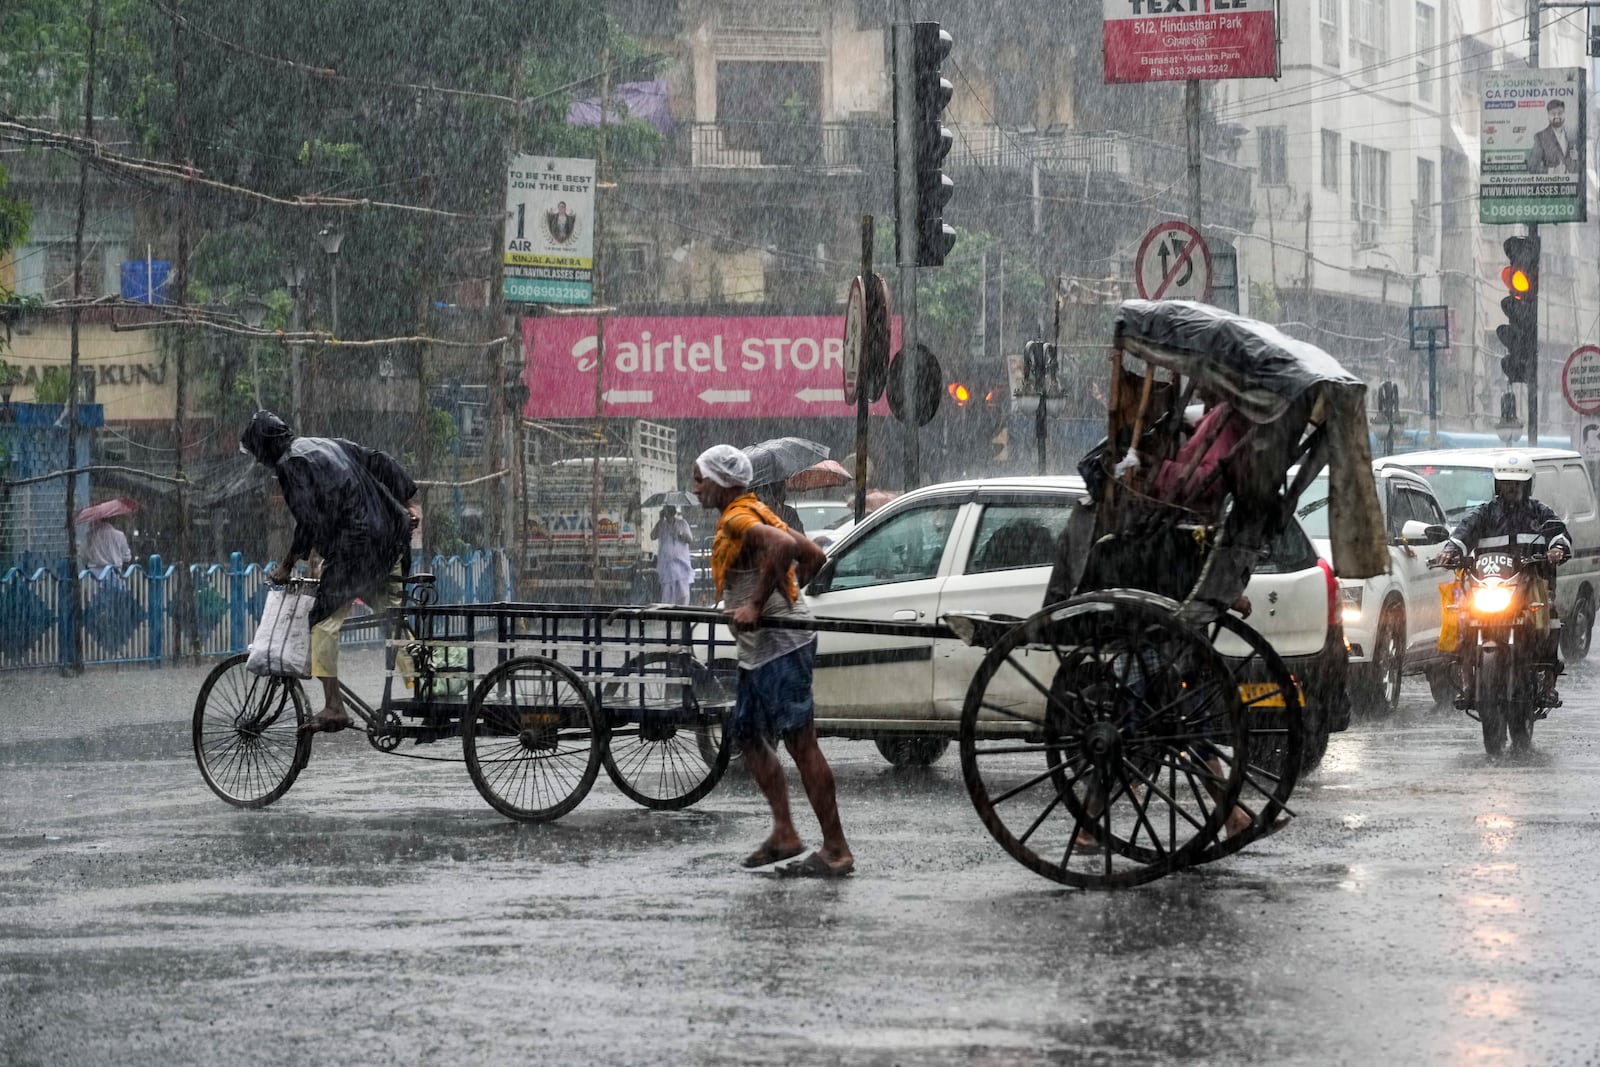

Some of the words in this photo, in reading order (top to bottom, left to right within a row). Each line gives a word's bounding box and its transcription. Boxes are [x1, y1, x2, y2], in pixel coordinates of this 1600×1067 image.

[1134, 20, 1158, 35] 51/2,
[1160, 19, 1217, 33] Hindusthan
[1219, 16, 1242, 30] Park
[1141, 56, 1178, 65] Barasat
[1169, 66, 1185, 75] 033
[1209, 64, 1229, 73] 2242
[1485, 89, 1501, 98] CA
[1504, 87, 1574, 98] FOUNDATION
[510, 170, 523, 179] TO
[526, 172, 539, 180] BE
[542, 173, 564, 182] THE
[566, 175, 592, 183] BEST
[512, 181, 536, 190] JOIN
[539, 183, 559, 191] THE
[563, 184, 590, 193] BEST
[1482, 185, 1577, 196] WWW.NAVINCLASSES.COM
[1490, 204, 1575, 217] 08069032130
[517, 203, 526, 239] 1
[508, 240, 532, 252] AIR
[512, 254, 543, 264] KINJAL
[545, 256, 582, 267] AJMERA
[510, 284, 589, 300] 08069032130
[615, 331, 727, 373] airtel
[741, 337, 844, 372] STOR
[99, 364, 168, 385] KUNJ
[1476, 555, 1513, 569] POLICE
